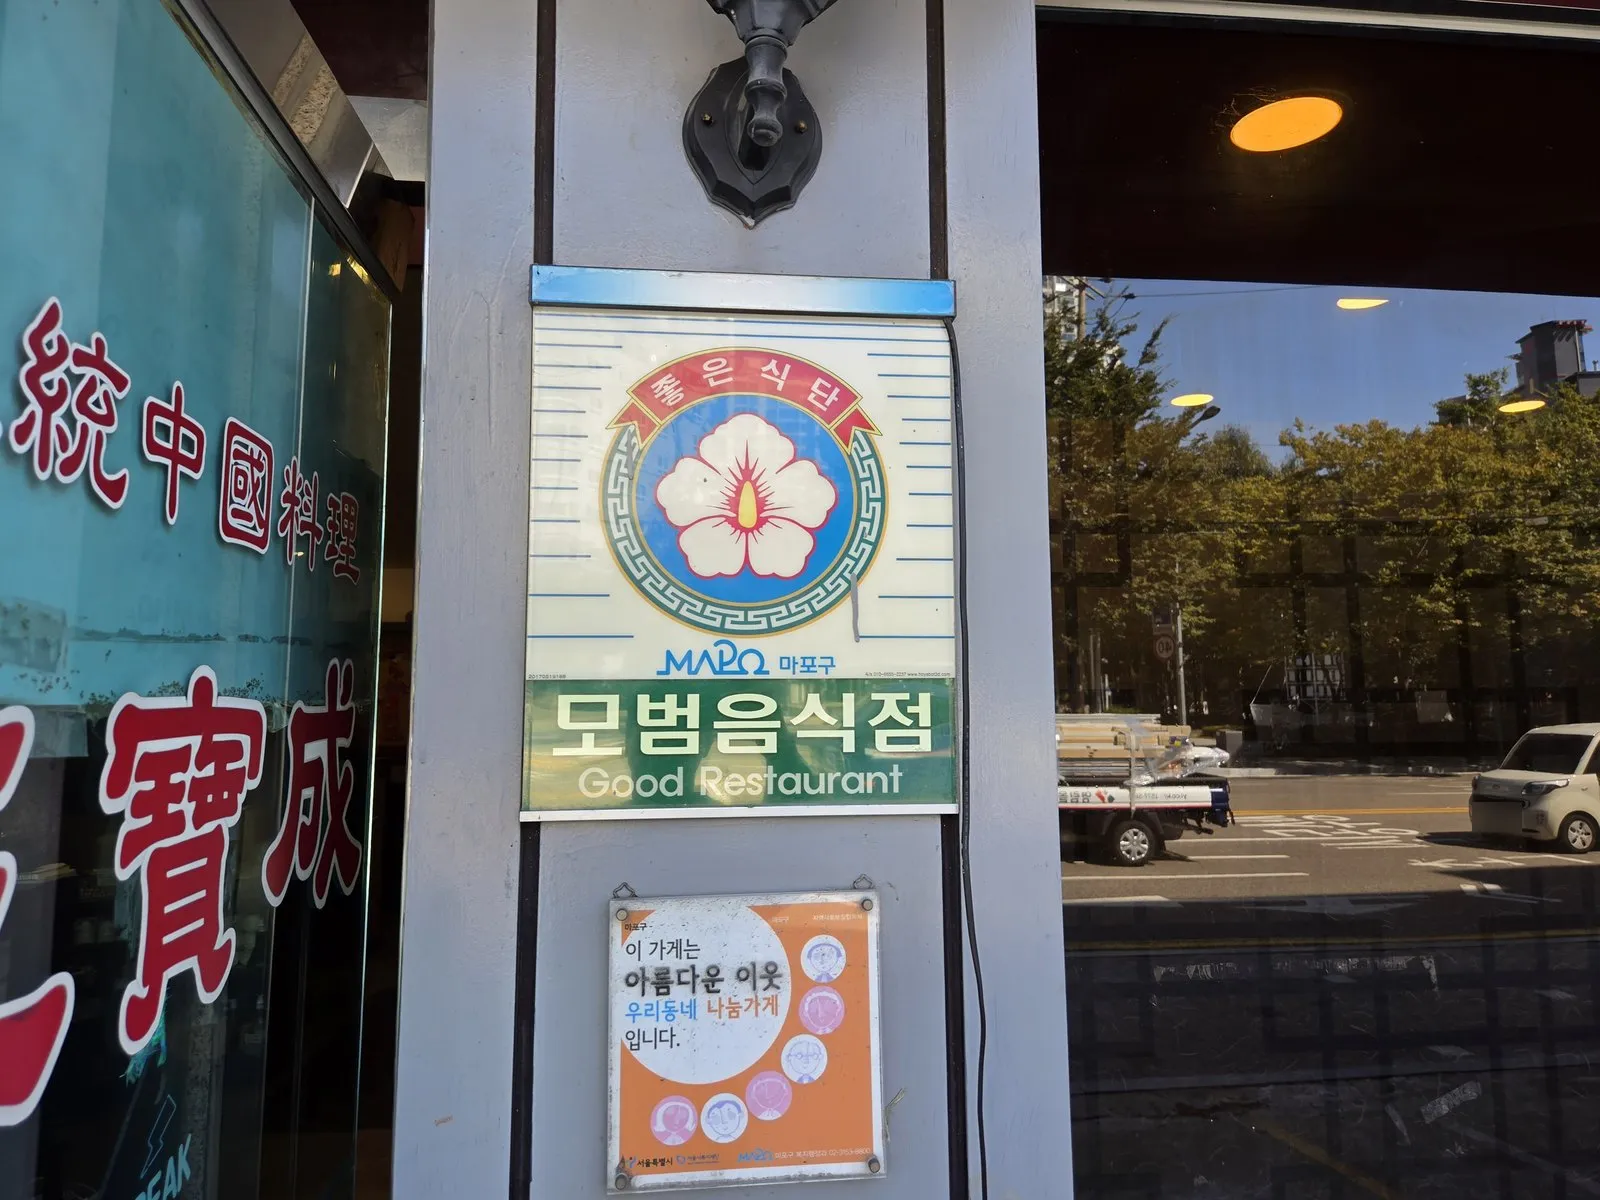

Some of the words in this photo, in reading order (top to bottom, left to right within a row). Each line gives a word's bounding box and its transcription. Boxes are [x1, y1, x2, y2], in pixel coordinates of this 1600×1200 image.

[650, 356, 735, 407] 좋은
[760, 358, 841, 412] 식단
[0, 295, 361, 586] 統中國料理
[656, 639, 770, 676] MAPO
[779, 655, 836, 675] 마포구
[552, 692, 933, 757] 모범음식점
[578, 766, 684, 799] Good
[699, 764, 903, 798] Restaurant
[625, 942, 641, 962] 이
[649, 938, 701, 960] 가게는
[624, 964, 725, 997] 아름다운
[735, 959, 783, 993] 이웃
[624, 998, 698, 1023] 우리동네
[706, 994, 780, 1020] 나눔가게
[625, 1027, 680, 1052] 입니다.
[134, 1133, 192, 1200] EAK
[636, 1157, 673, 1168] 서울특별시
